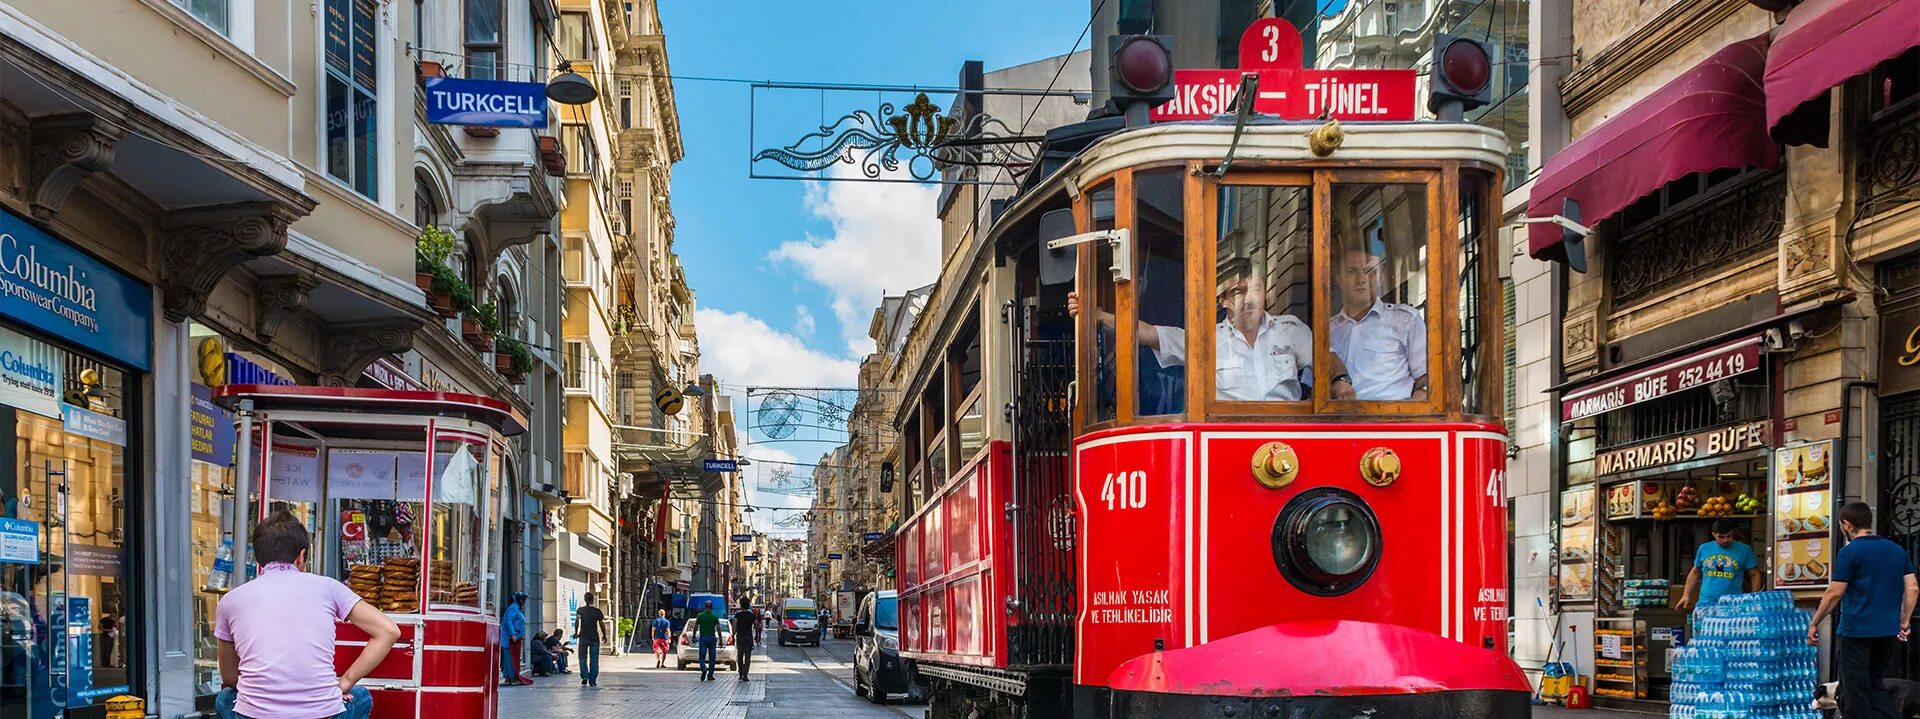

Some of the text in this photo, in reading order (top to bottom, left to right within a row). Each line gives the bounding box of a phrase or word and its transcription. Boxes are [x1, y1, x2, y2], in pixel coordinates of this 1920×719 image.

[1262, 26, 1279, 62] 3
[433, 91, 541, 114] TURKCELL
[1304, 78, 1388, 114] TÜNEL
[0, 233, 97, 312] Columbia
[2, 350, 55, 386] Columbia
[1571, 353, 1744, 418] MARMARİS BÜFE 252 44 19
[1600, 423, 1765, 475] MARMARİS BÜFE
[1101, 470, 1147, 510] 410
[1093, 589, 1169, 605] ASILMAK YASAK
[1101, 607, 1172, 623] TEHLİKELİDİR
[1473, 607, 1487, 621] VE
